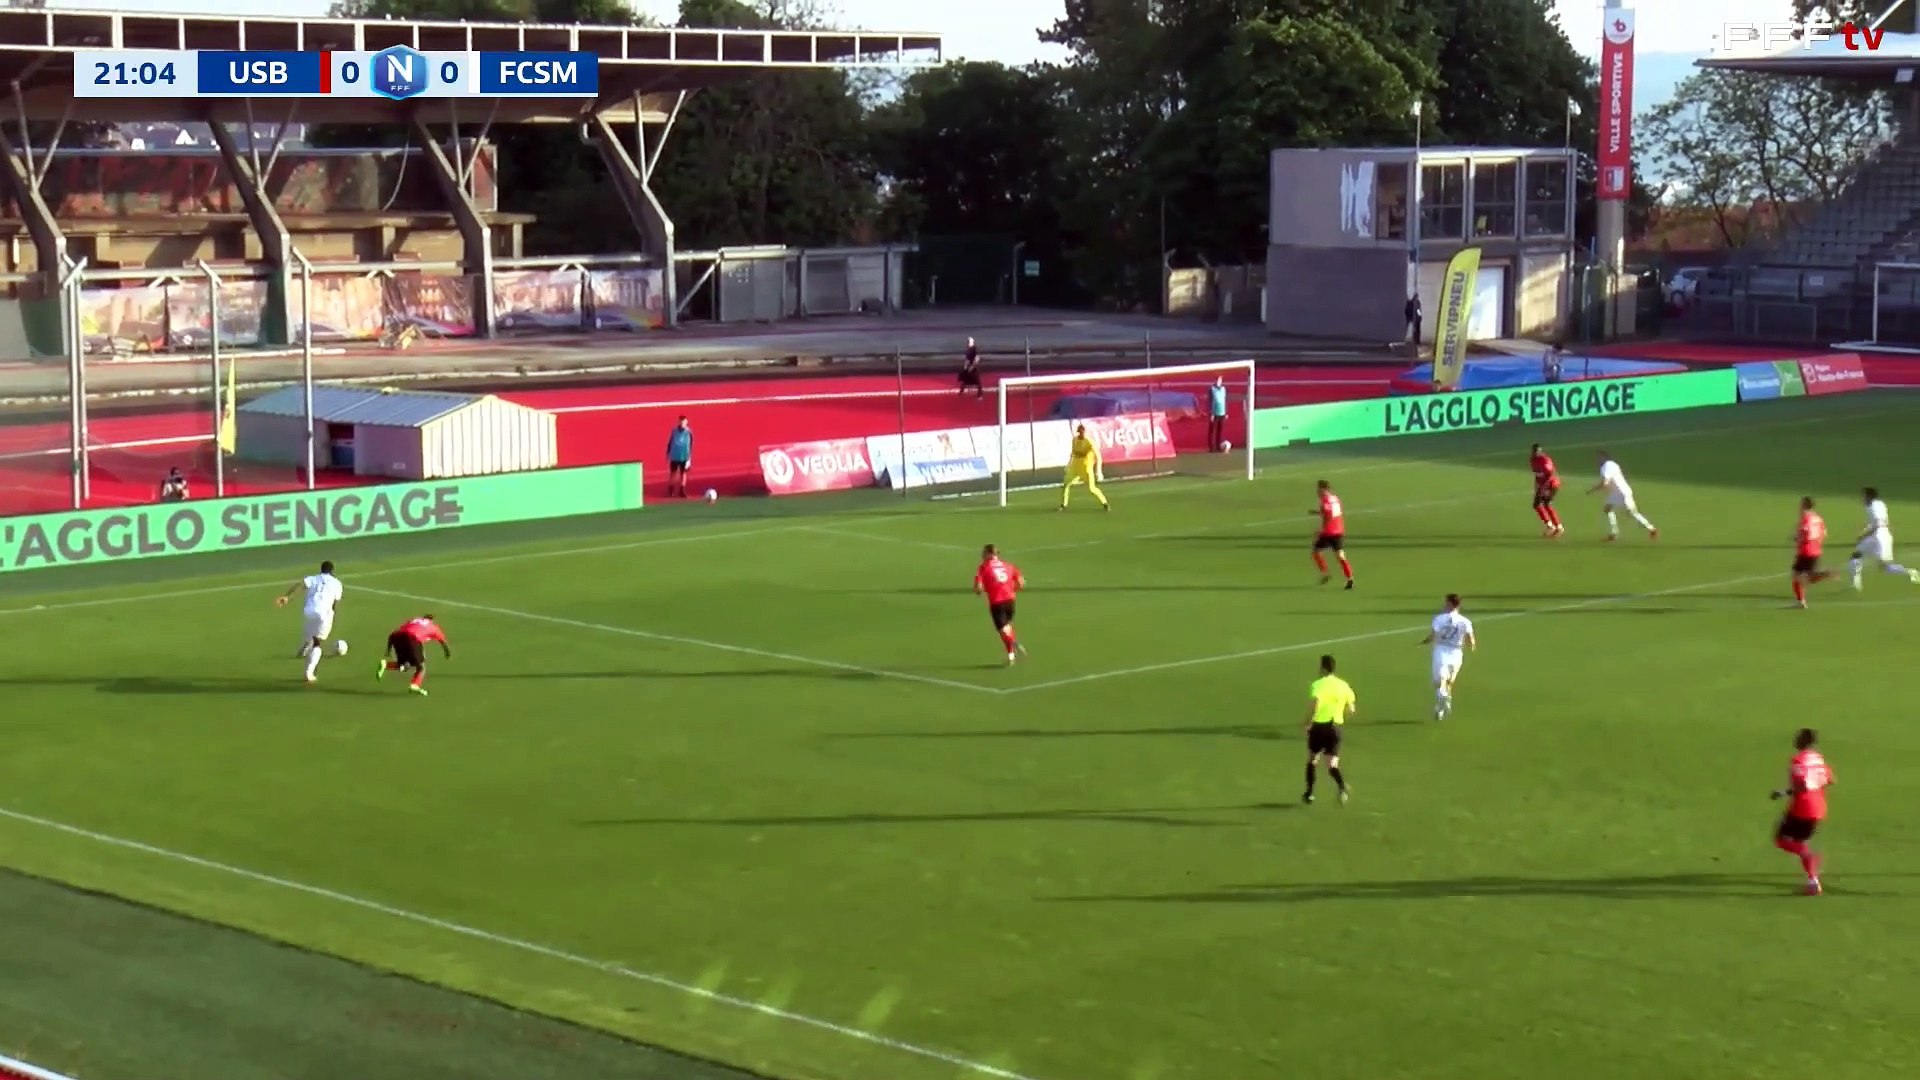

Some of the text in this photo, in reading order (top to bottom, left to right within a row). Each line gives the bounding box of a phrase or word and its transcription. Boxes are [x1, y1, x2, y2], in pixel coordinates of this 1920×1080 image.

[1611, 51, 1623, 115] SPORTIVE
[1610, 117, 1621, 153] VILLE
[1442, 270, 1465, 367] SERVIPNEU
[1385, 382, 1636, 433] L'AGGLO S'ENGAGE
[1102, 425, 1168, 448] VEOLIA
[794, 452, 869, 476] VEOLIA
[0, 485, 463, 567] 'AGGLO S'ENGAGE
